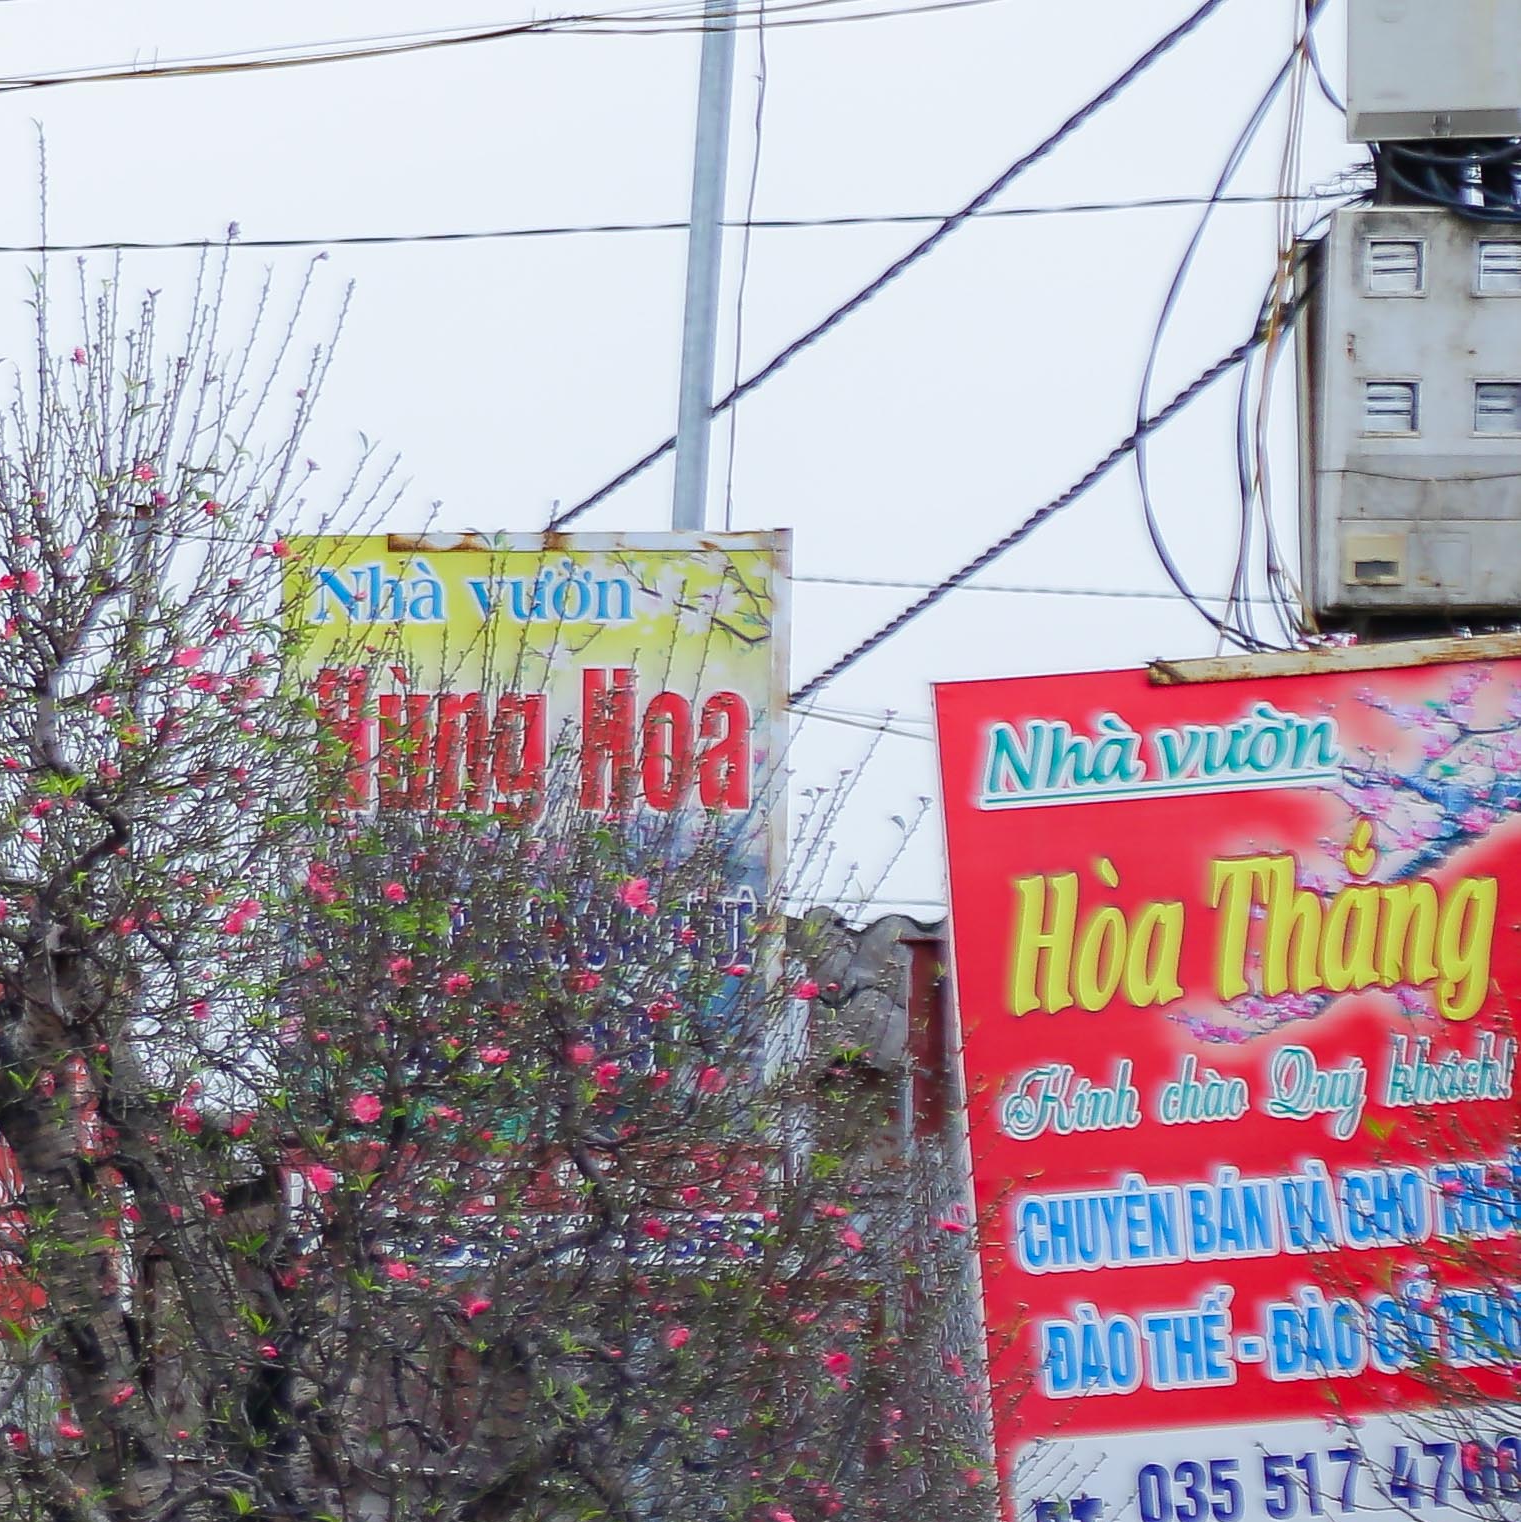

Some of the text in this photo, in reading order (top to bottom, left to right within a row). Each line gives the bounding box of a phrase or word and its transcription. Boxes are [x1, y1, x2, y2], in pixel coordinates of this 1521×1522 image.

[315, 557, 635, 622] Nhà vườn
[579, 667, 753, 813] Hoa
[985, 702, 1341, 797] Nhà vườn
[1010, 820, 1499, 1022] Hòa Thắng
[1002, 1030, 1520, 1142] Kính chào Quý khách!
[1017, 1173, 1185, 1274] CHUYÊN
[1186, 1165, 1279, 1262] BÁN
[1279, 1159, 1340, 1253] VÀ
[1339, 1165, 1434, 1250] CHO
[1040, 1301, 1142, 1399] ĐÀO
[1141, 1284, 1238, 1391] THẾ
[1266, 1285, 1368, 1382] ĐÀO
[1263, 1448, 1363, 1521] 517
